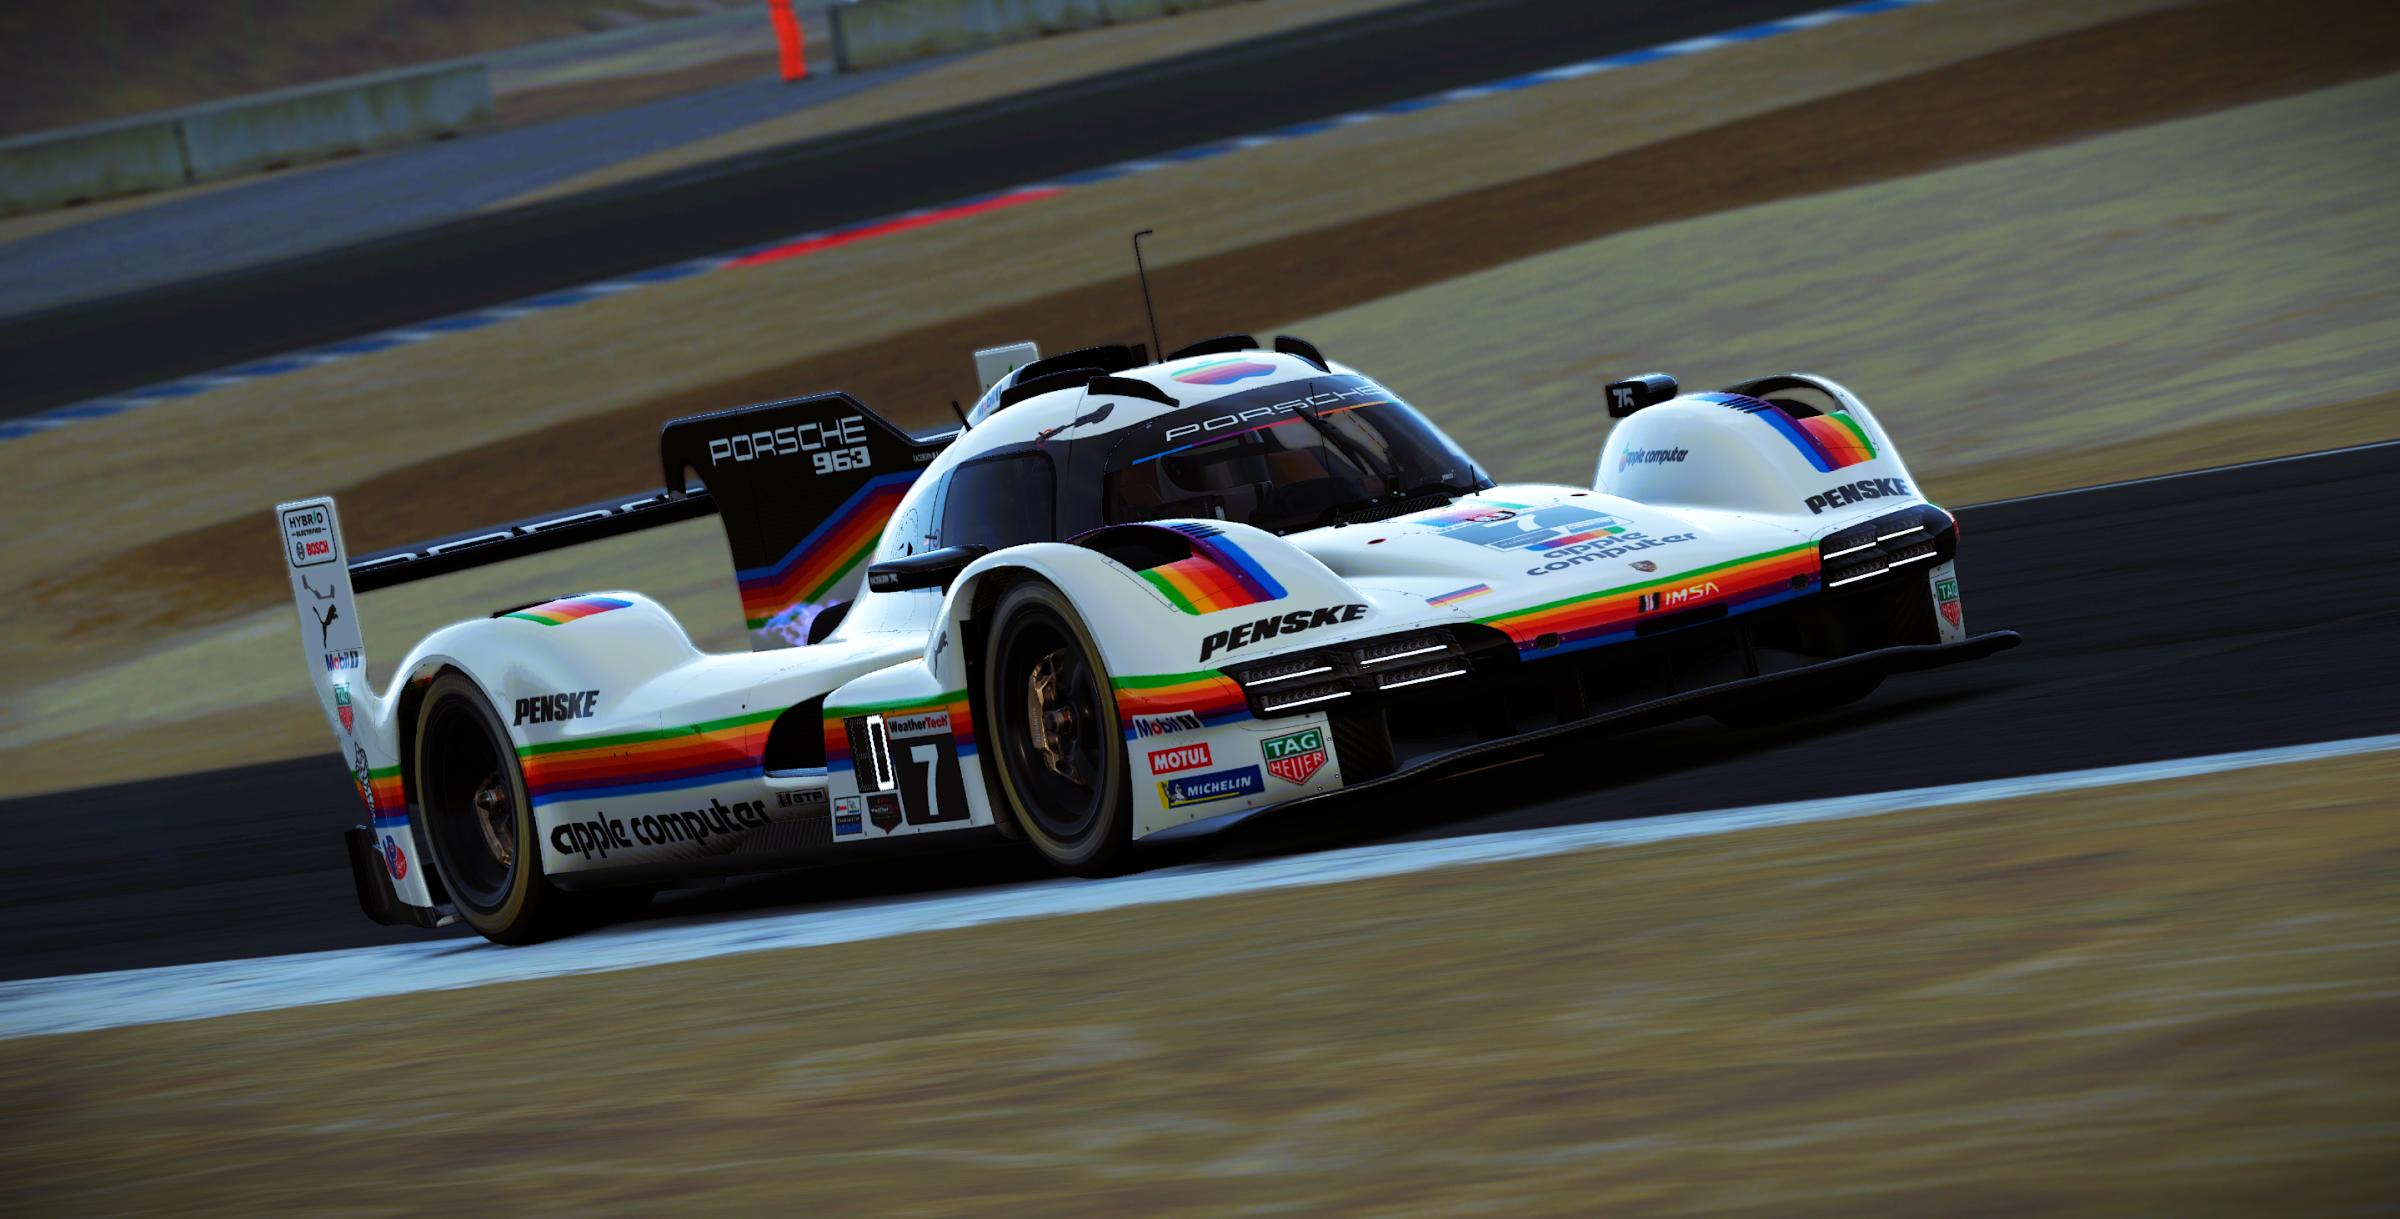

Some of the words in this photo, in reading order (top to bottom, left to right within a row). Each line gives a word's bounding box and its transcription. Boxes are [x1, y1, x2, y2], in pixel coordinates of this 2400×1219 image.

[1164, 384, 1381, 442] PORSCHE
[709, 415, 867, 468] PORSCHE
[812, 445, 873, 476] 963
[1804, 477, 1912, 515] PENSKE
[288, 511, 323, 528] HYBRID
[306, 540, 330, 556] BOSCH
[1526, 530, 1701, 577] computer
[1543, 530, 1649, 559] apple
[1665, 582, 1720, 606] IMSA
[1200, 604, 1368, 662] PENSKE
[325, 652, 350, 671] Mobil
[513, 690, 599, 727] PENSKE
[888, 716, 947, 734] WeatherTech
[1135, 716, 1182, 738] Mobil
[1153, 746, 1209, 772] MOTUL
[1268, 733, 1317, 758] TAG
[910, 743, 939, 817] 7
[1269, 751, 1324, 784] HEUER
[793, 791, 822, 803] GTP
[1187, 775, 1252, 798] MICHELIN
[550, 812, 627, 860] apple
[635, 798, 773, 851] computer
